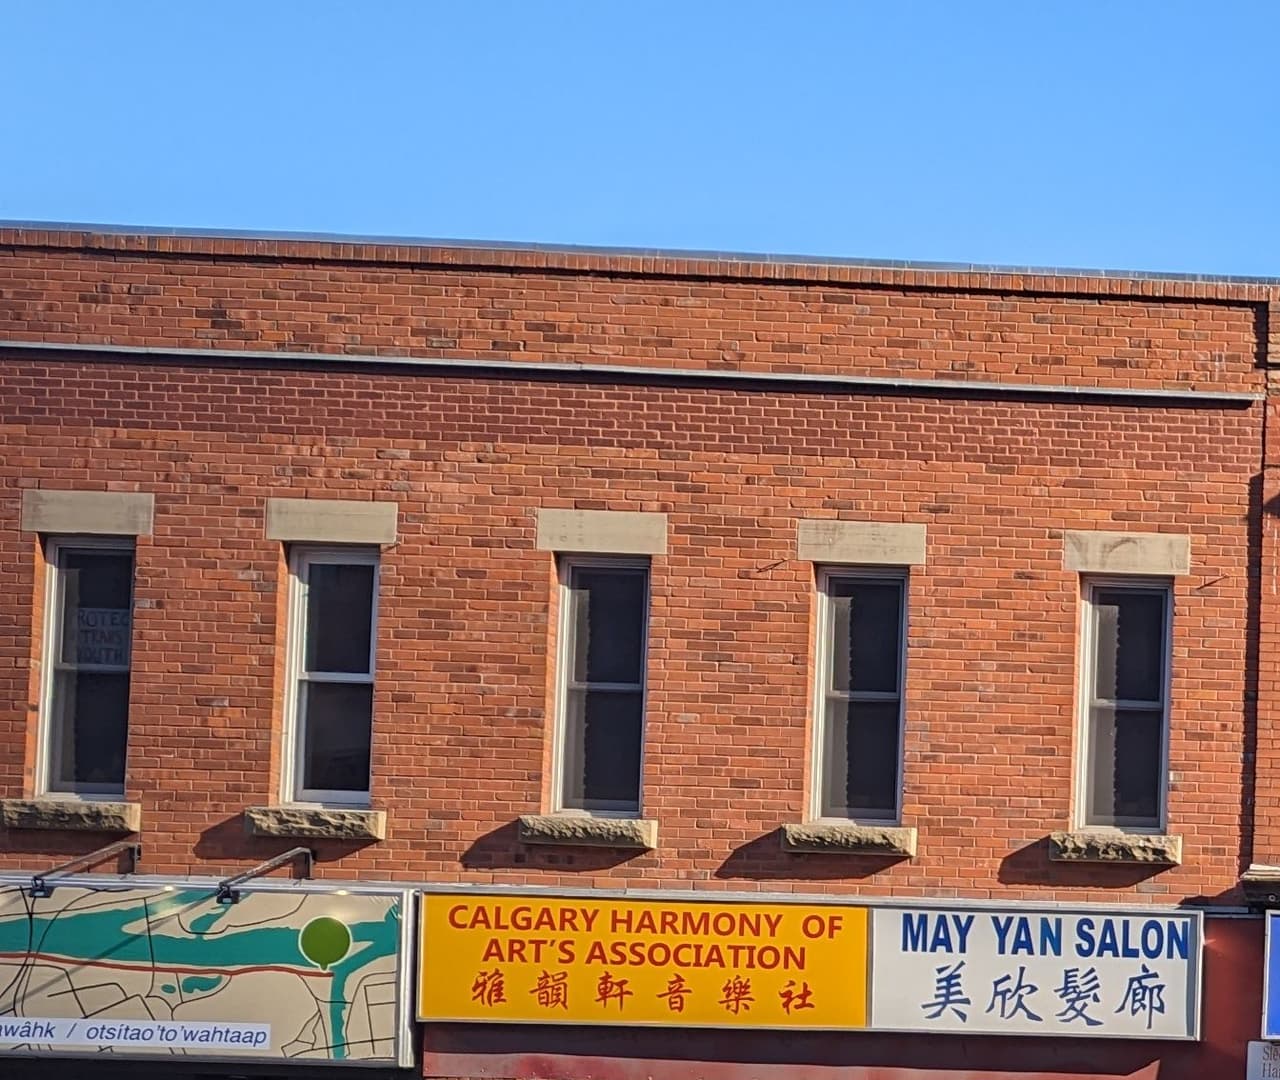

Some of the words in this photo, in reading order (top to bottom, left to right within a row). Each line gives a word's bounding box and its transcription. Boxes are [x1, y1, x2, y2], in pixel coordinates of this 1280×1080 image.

[448, 904, 600, 933] CALGARY
[610, 909, 784, 938] HARMONY
[801, 914, 844, 940] OF
[901, 913, 975, 954] MAY
[990, 916, 1063, 957] YAN
[1075, 917, 1189, 960] SALON
[481, 938, 576, 964] ART'S
[585, 941, 806, 970] ASSOCIATION
[471, 969, 816, 1015] 雅韻軒音樂社
[920, 960, 1166, 1030] 美欣髮廊
[0, 1021, 56, 1038] wâhk
